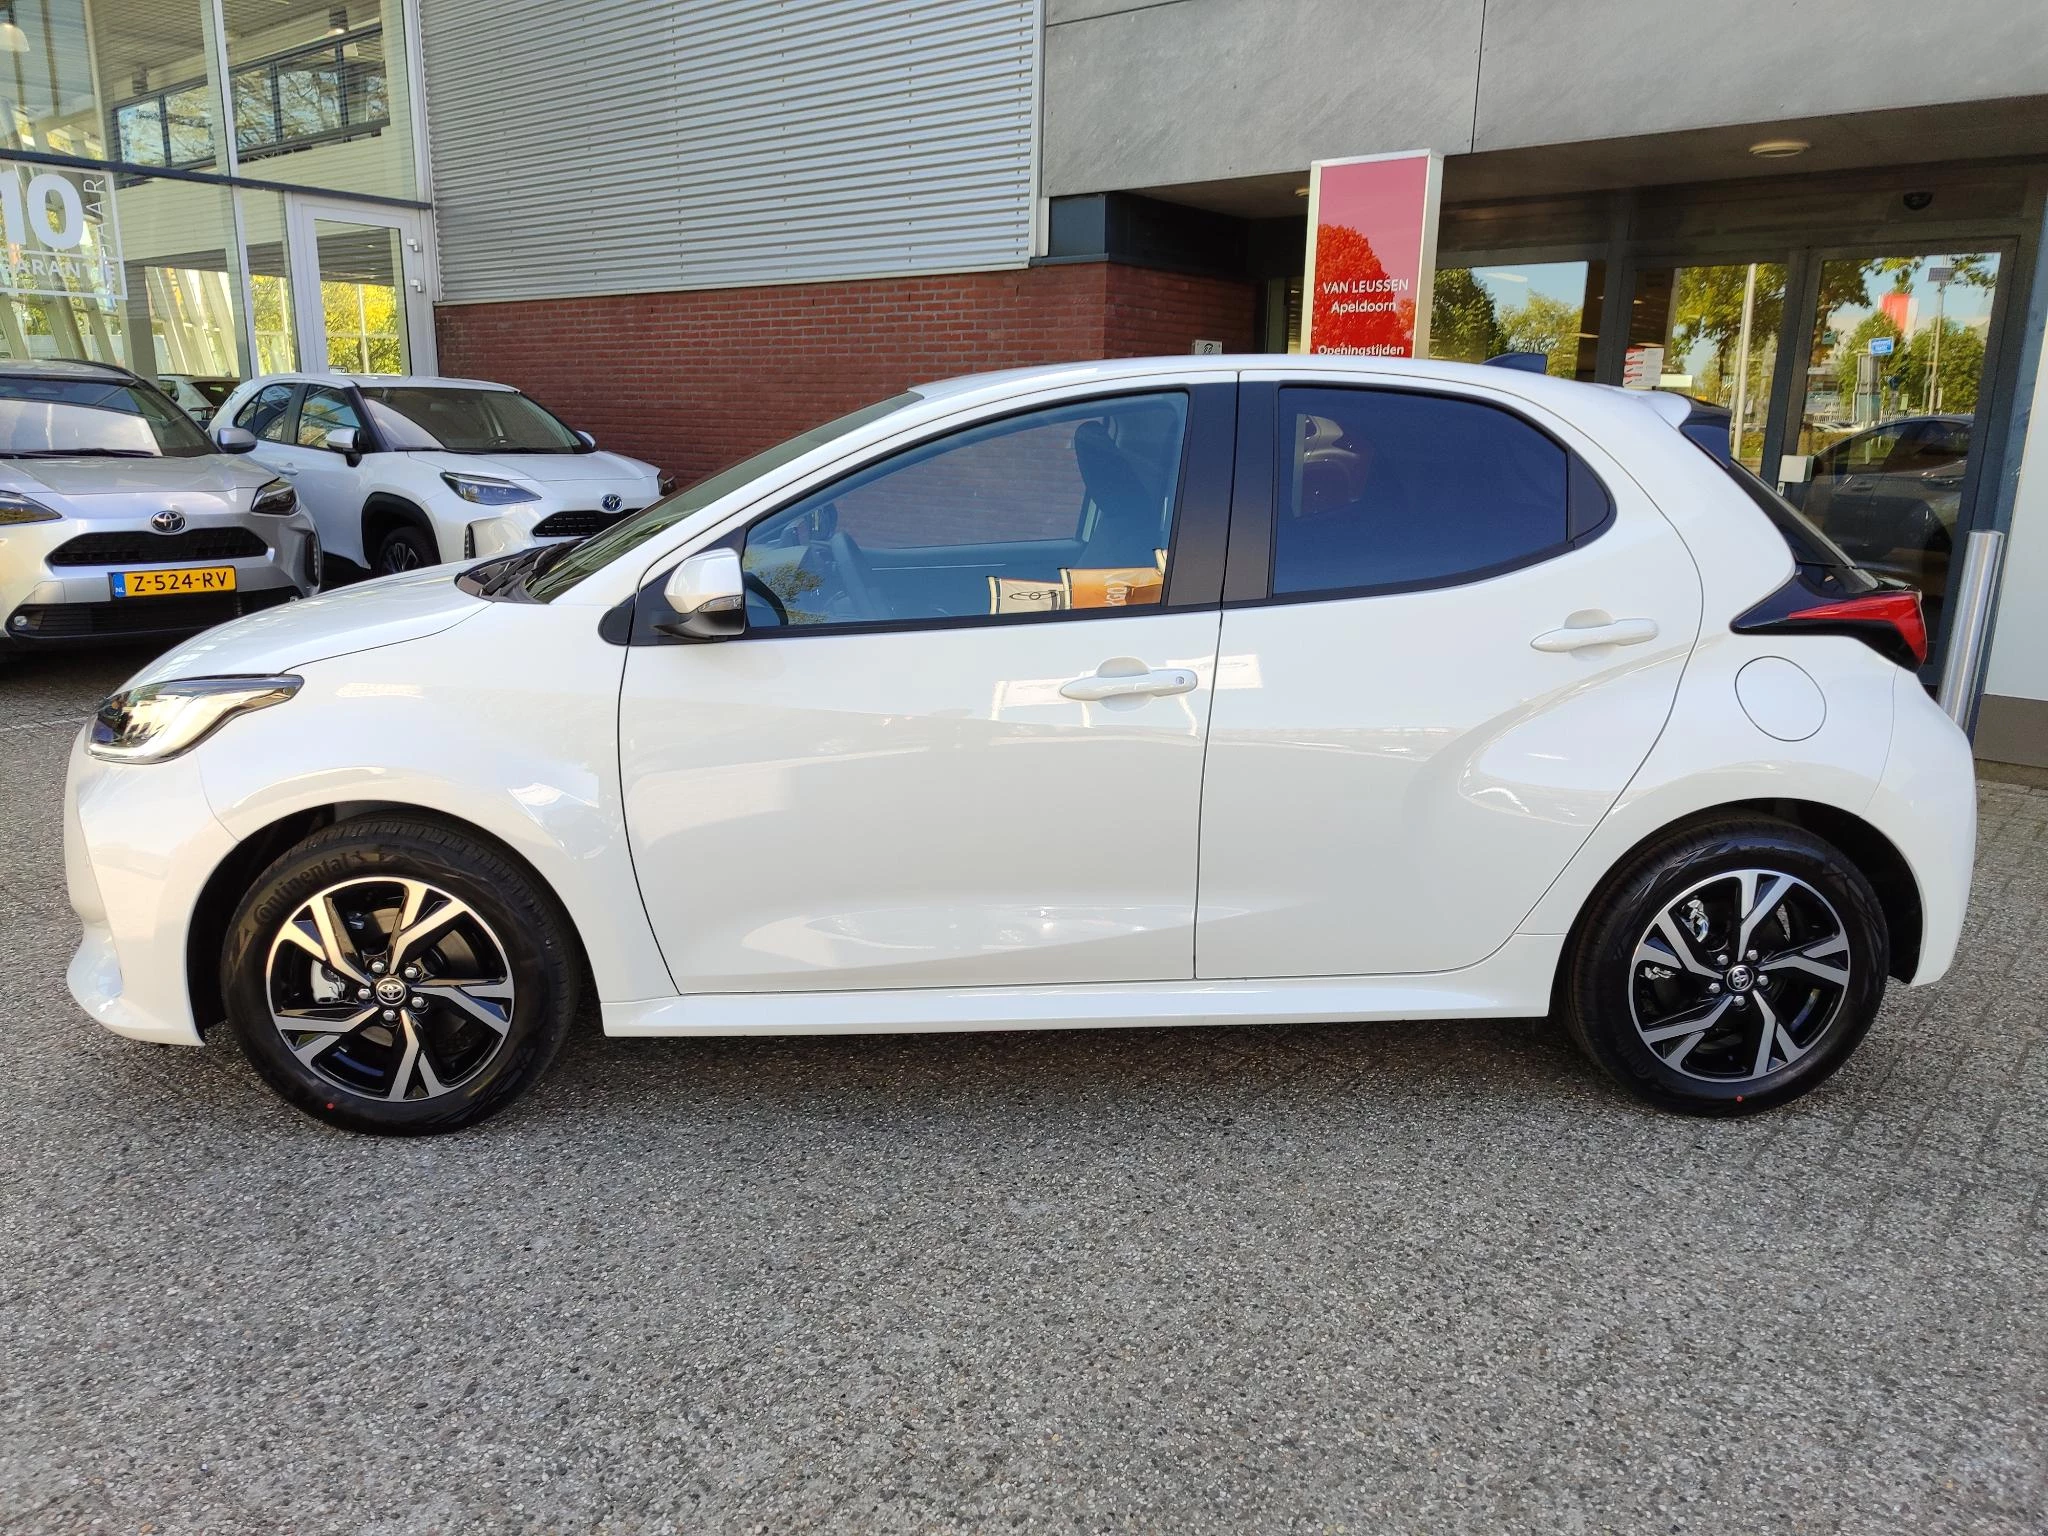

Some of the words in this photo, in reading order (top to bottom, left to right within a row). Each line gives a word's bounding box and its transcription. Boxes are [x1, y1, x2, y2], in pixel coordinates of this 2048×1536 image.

[0, 170, 84, 249] 10
[1322, 281, 1349, 295] VAN
[1351, 278, 1409, 294] LEUSSEN
[1330, 300, 1397, 315] Apeldoorn
[1317, 343, 1405, 357] Openingstijden
[133, 571, 227, 592] Z-524-RV
[254, 851, 349, 926] Continental
